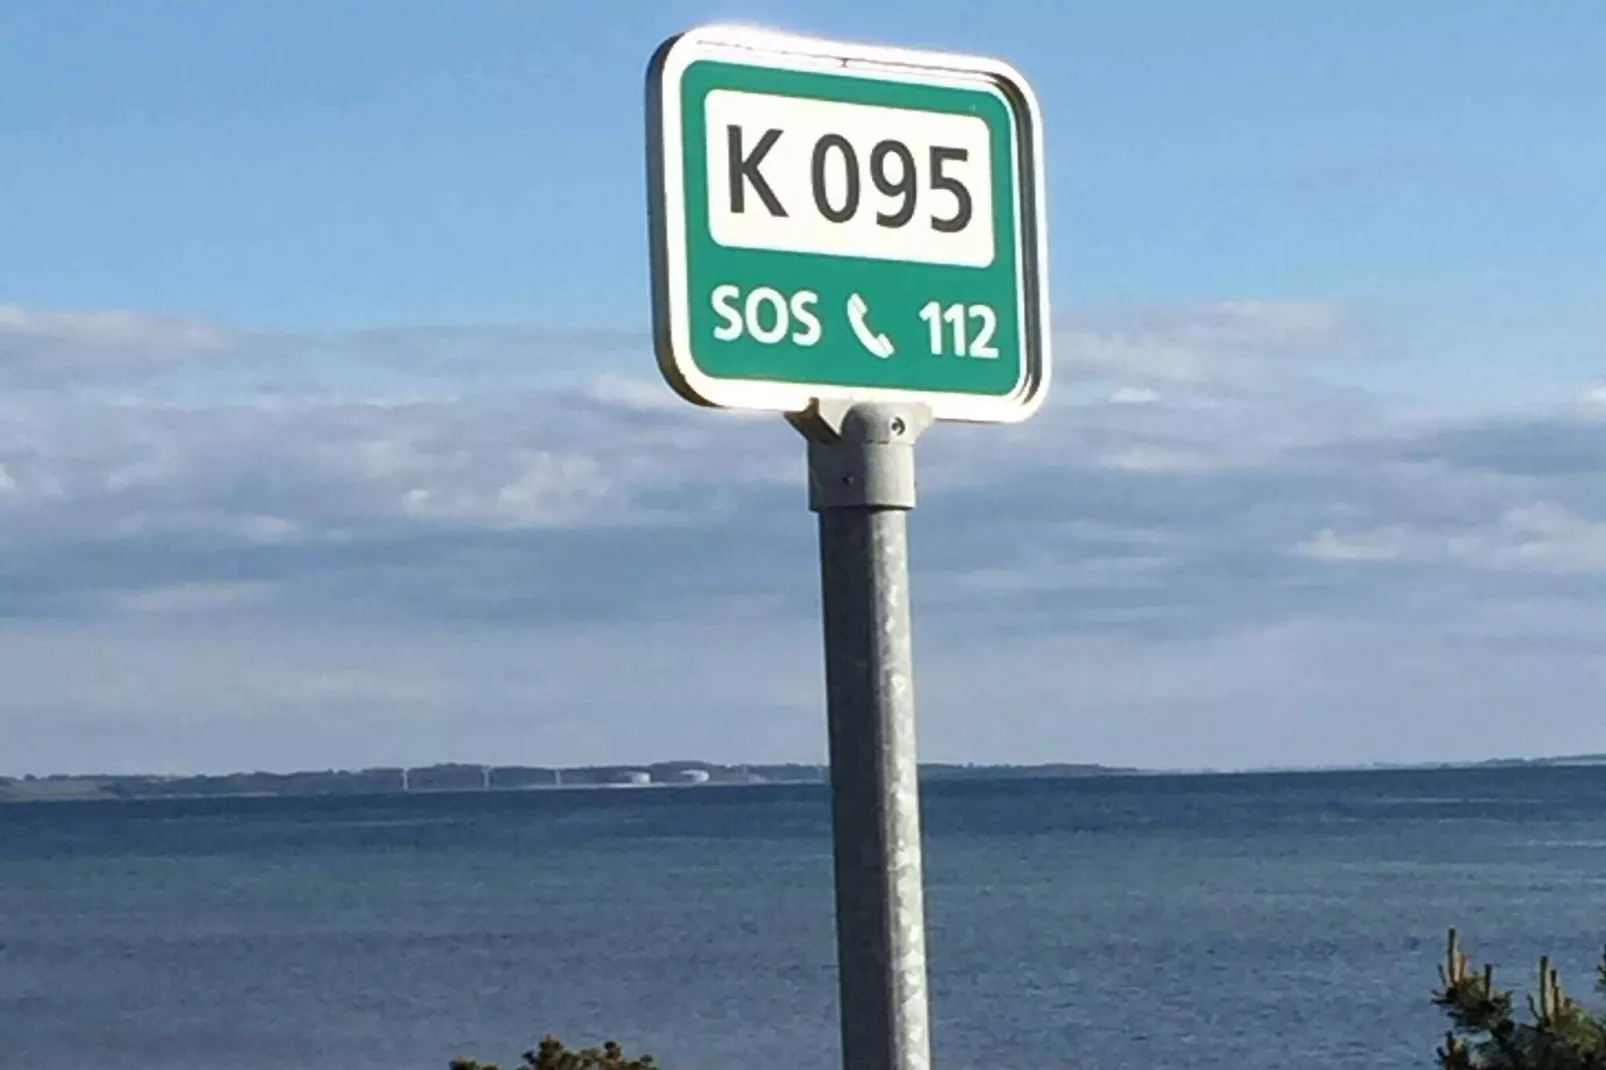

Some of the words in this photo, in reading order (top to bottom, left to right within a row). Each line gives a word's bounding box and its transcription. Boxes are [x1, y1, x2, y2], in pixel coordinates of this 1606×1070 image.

[727, 124, 788, 218] K
[811, 133, 972, 234] 095
[711, 285, 822, 346] SOS
[919, 301, 999, 359] 112
